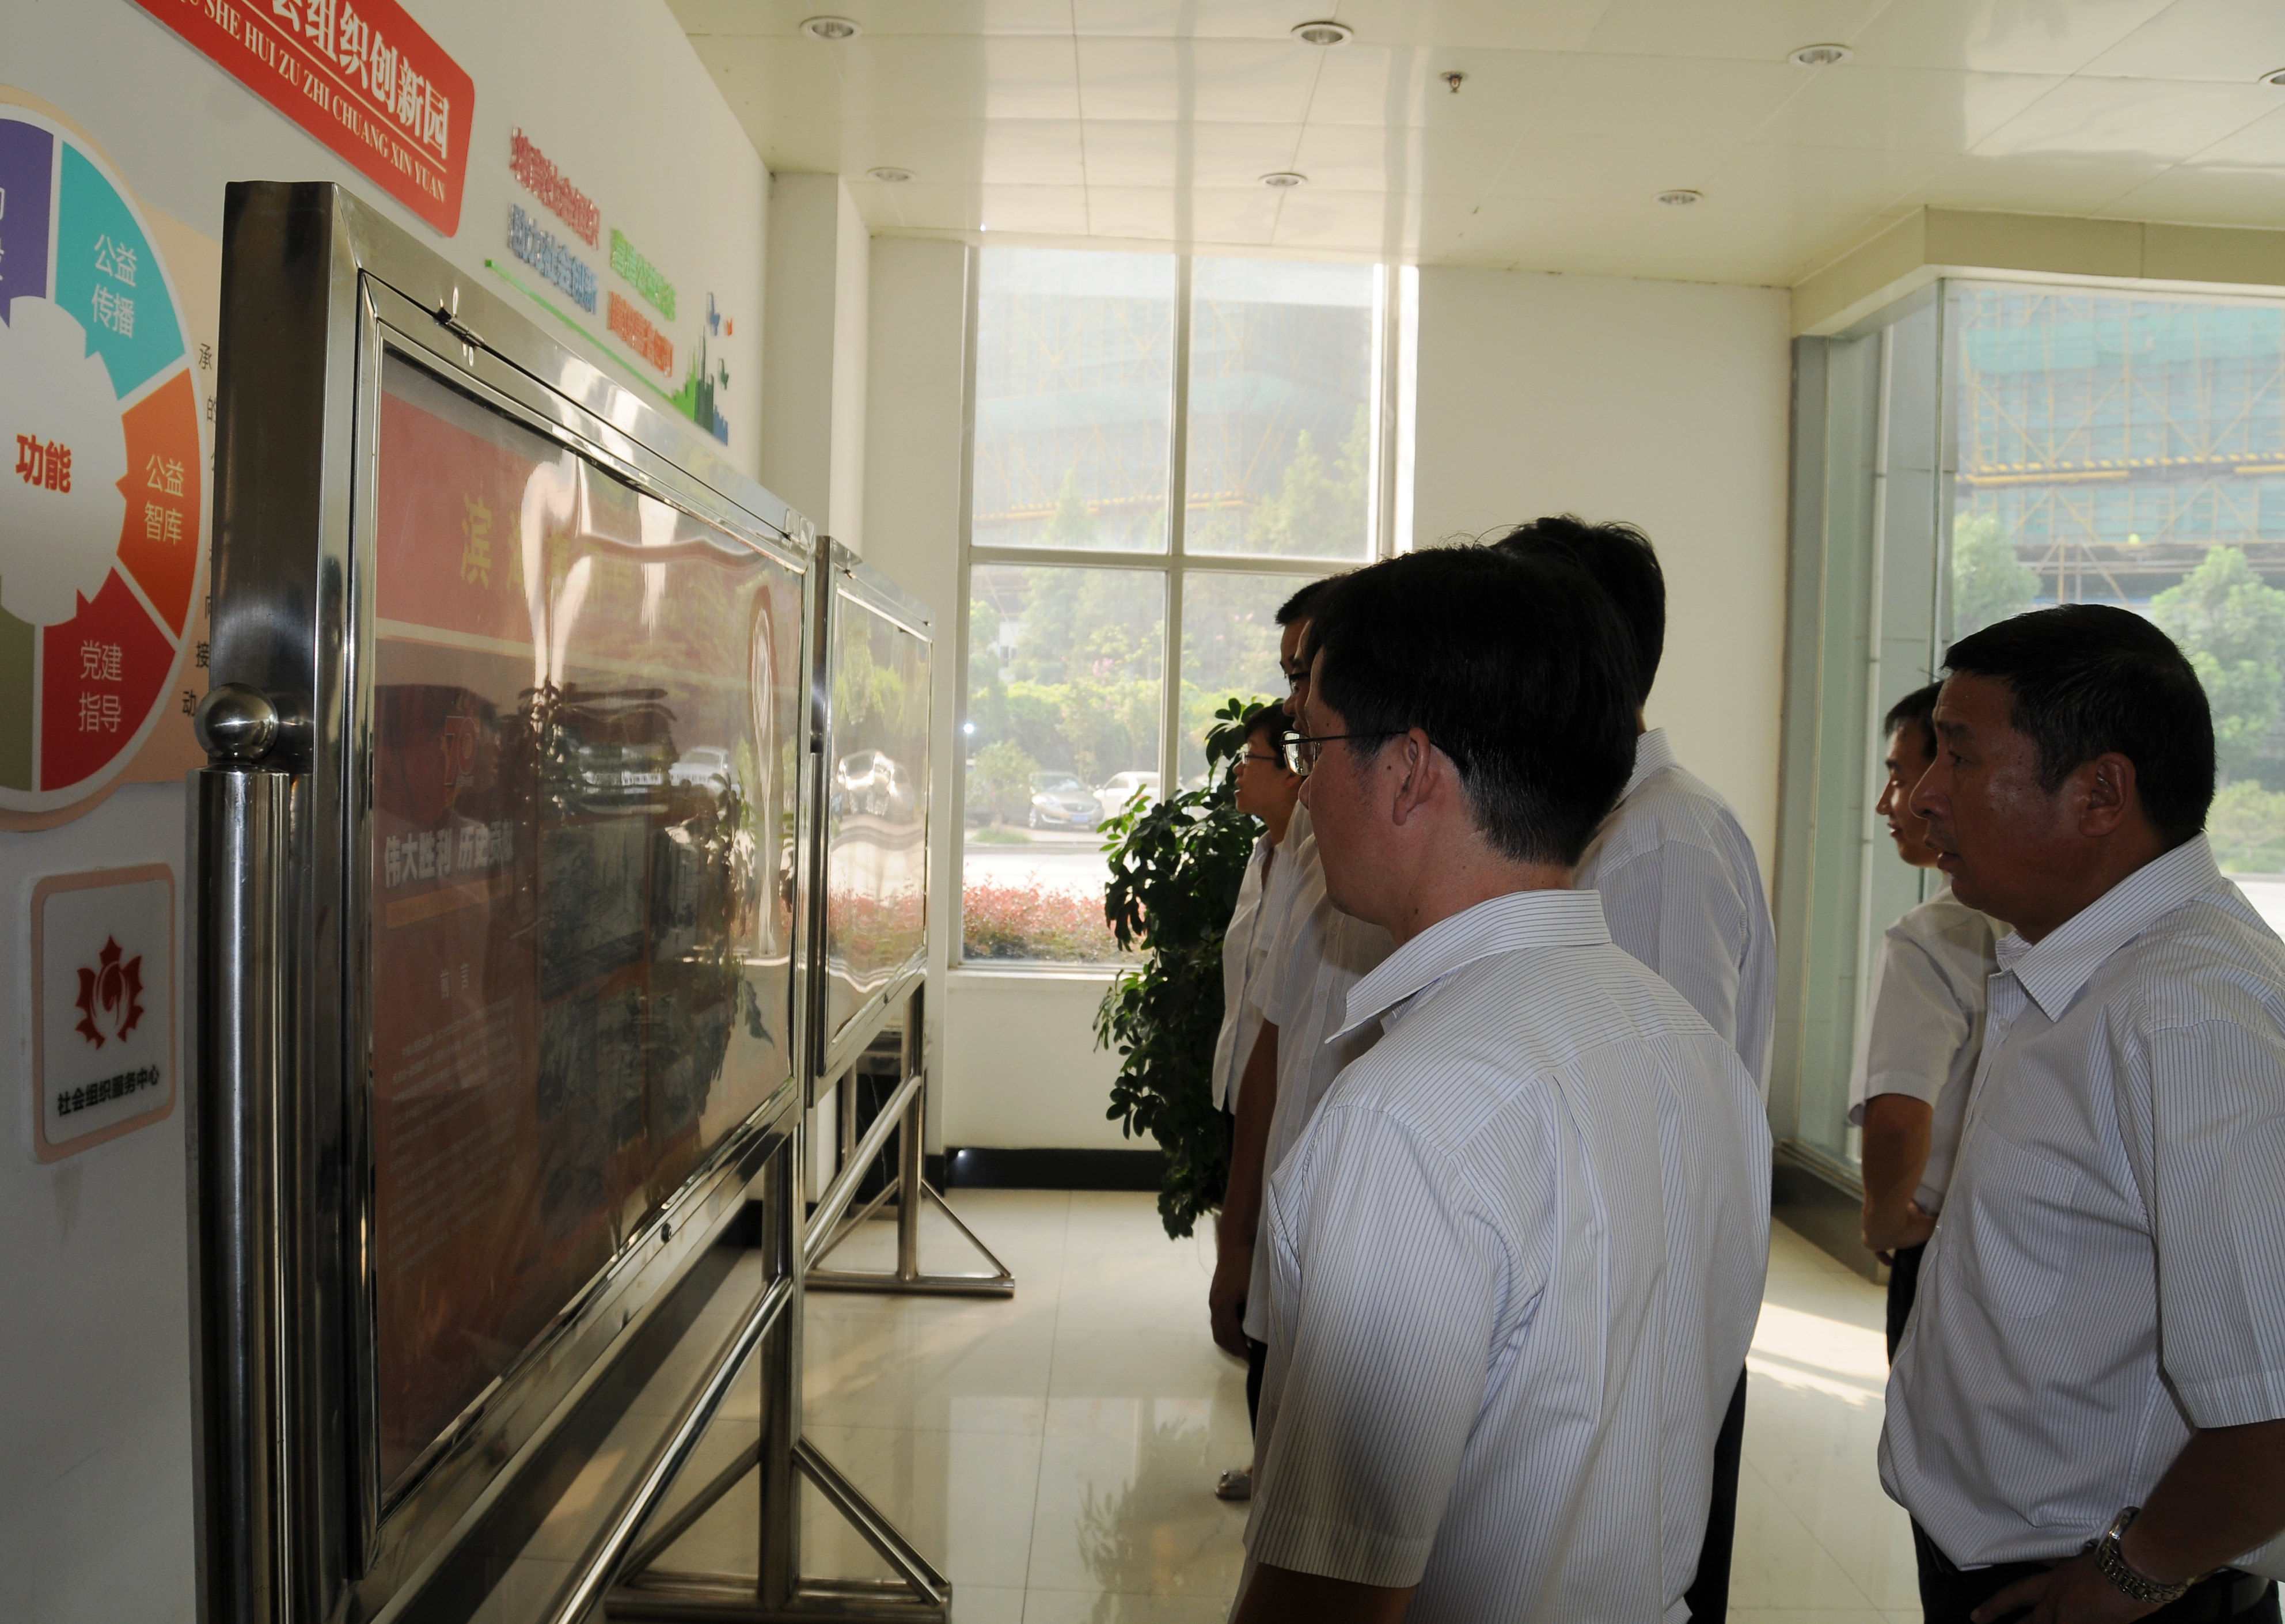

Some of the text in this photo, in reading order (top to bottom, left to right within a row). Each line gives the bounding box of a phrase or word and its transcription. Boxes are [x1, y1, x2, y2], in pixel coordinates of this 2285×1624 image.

[204, 0, 446, 203] SHE HUI ZU ZHI CHUANG XIN YUAN
[94, 234, 138, 286] 公益
[91, 283, 135, 339] 传播
[15, 434, 72, 494] 功能
[146, 454, 184, 497] 公益
[144, 500, 183, 544] 智库
[80, 640, 123, 682] 党建
[78, 692, 121, 733] 指导
[58, 1064, 159, 1117] 社会组织服务中心
